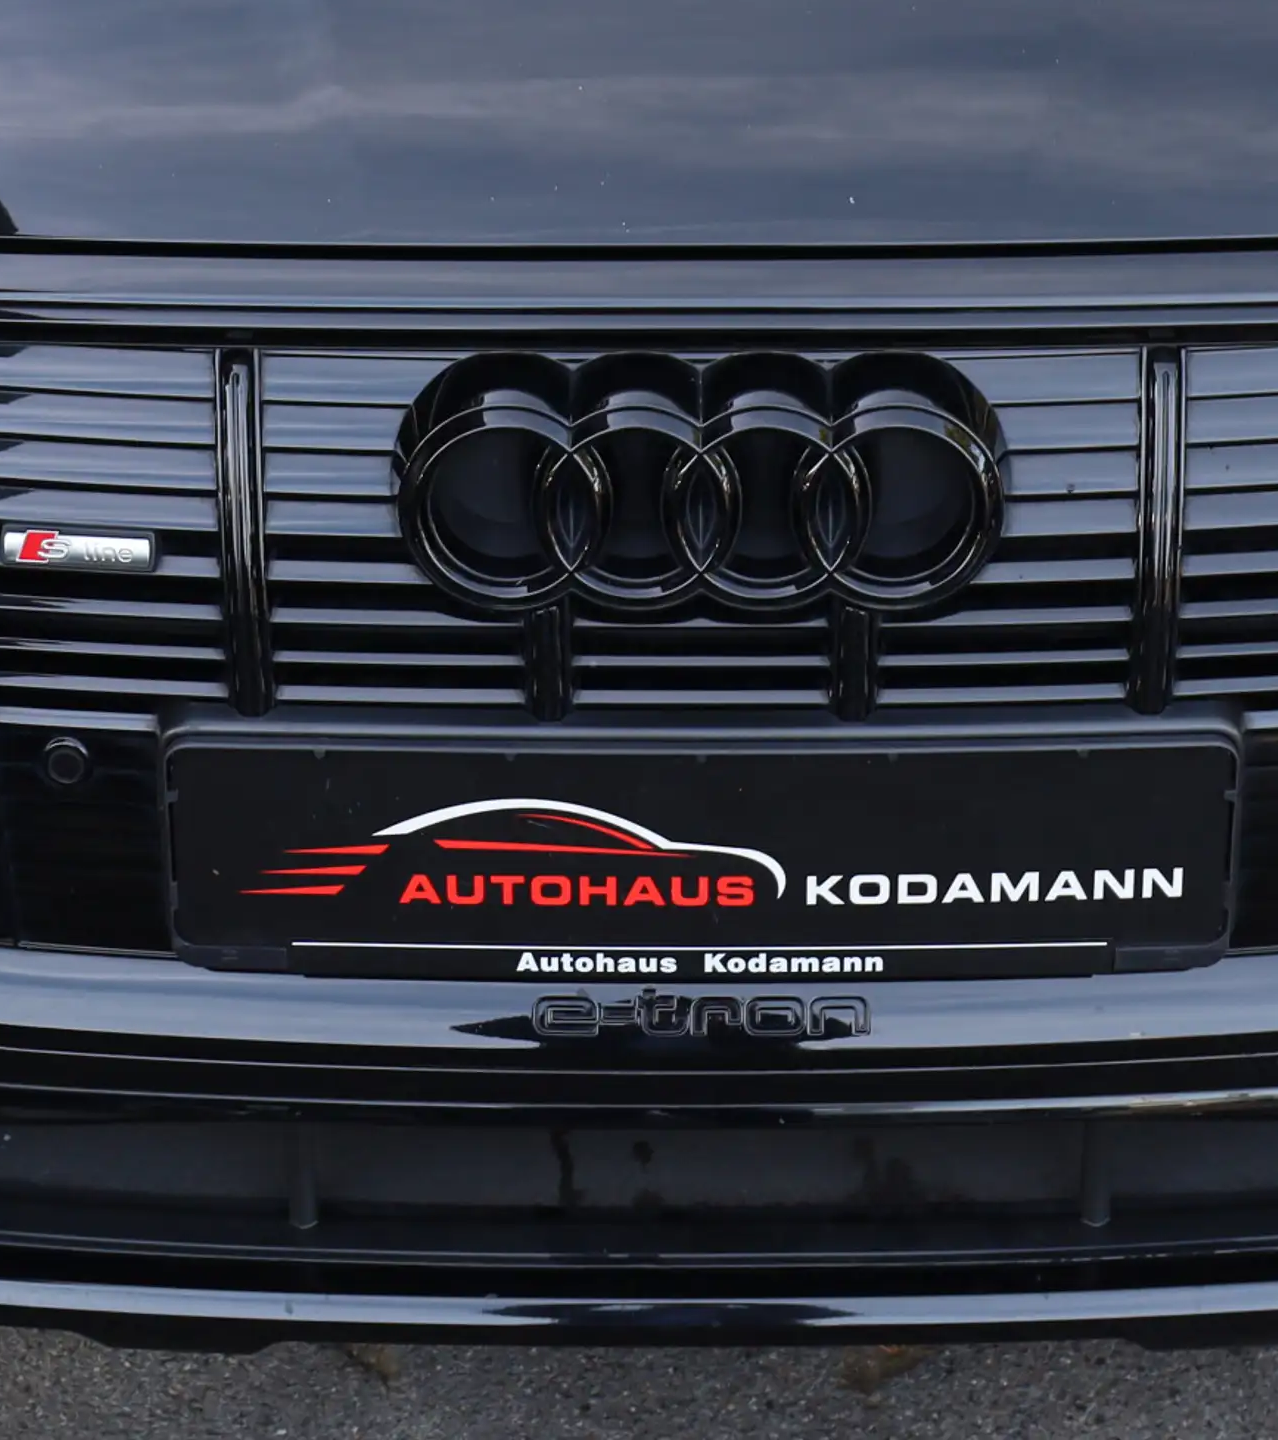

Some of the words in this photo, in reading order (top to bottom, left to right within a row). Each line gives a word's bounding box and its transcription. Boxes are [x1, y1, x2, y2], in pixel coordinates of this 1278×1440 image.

[83, 540, 134, 563] line
[398, 873, 756, 907] AUTOHAUS
[805, 866, 1184, 906] KODAMANN
[516, 951, 677, 974] Autohaus
[703, 951, 884, 974] Kodamann
[531, 985, 871, 1038] e-tron
